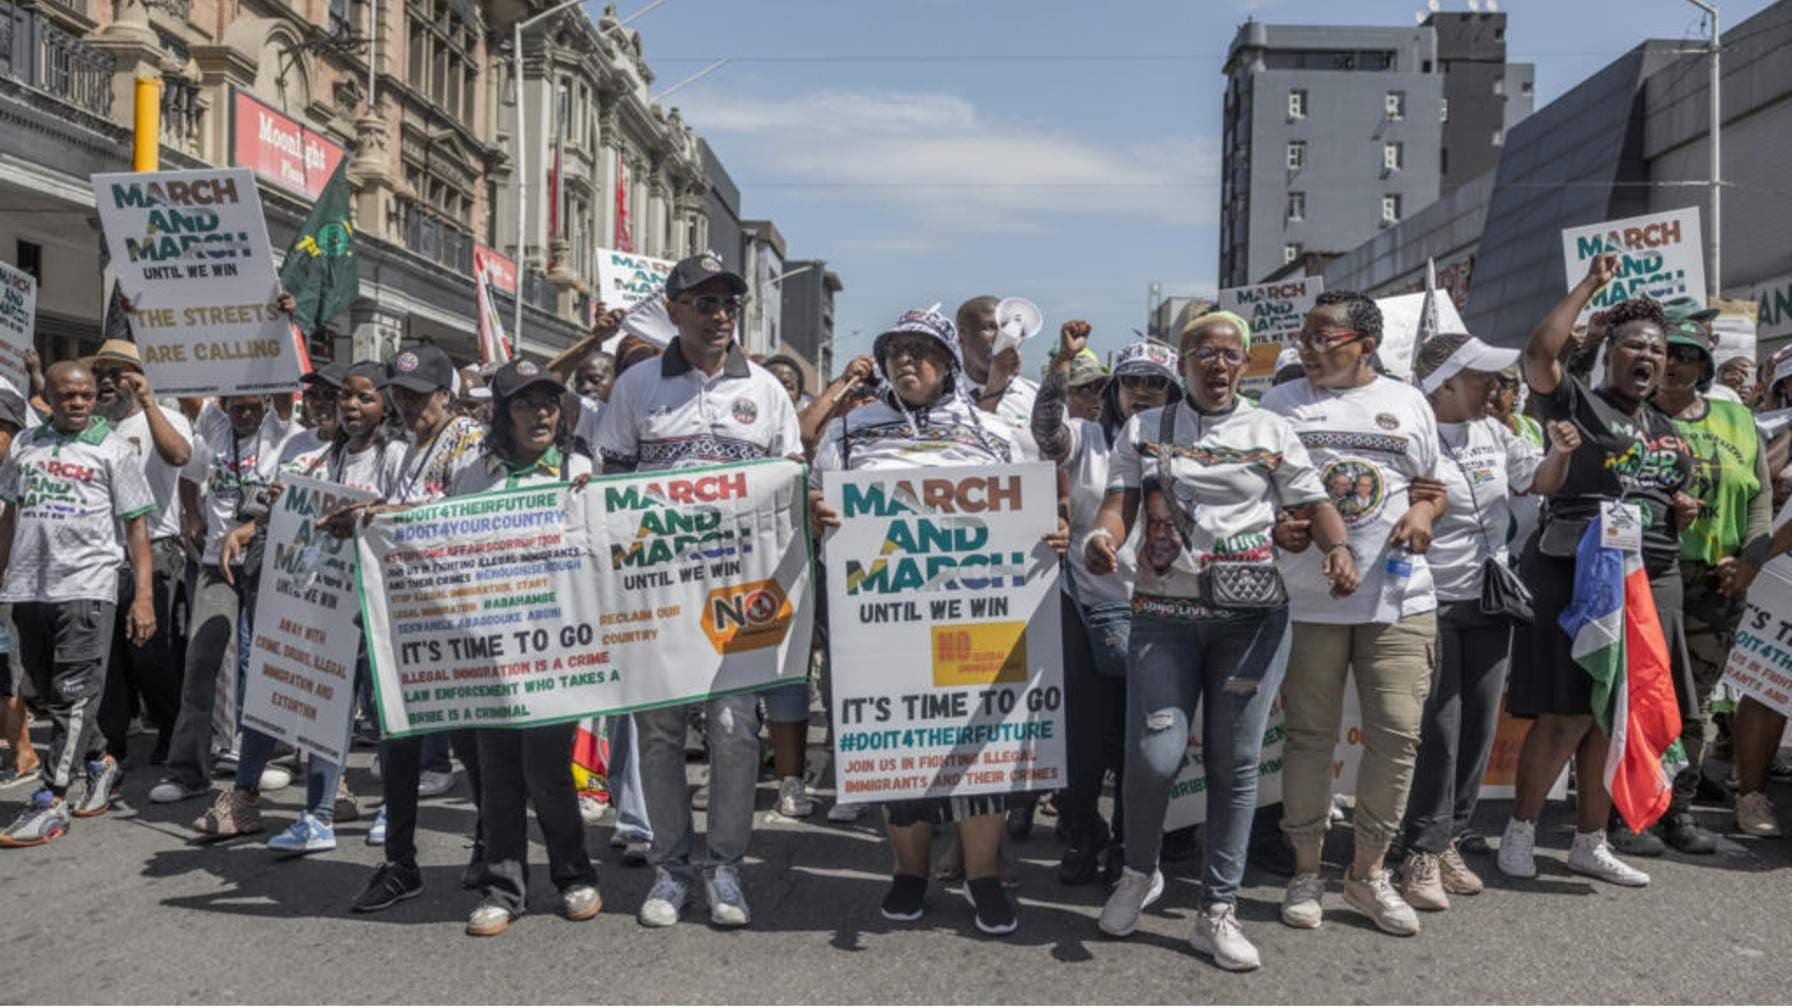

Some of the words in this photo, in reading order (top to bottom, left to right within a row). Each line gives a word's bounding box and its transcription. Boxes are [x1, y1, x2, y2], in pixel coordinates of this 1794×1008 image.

[258, 112, 326, 171] Moonlght
[112, 178, 239, 208] MARCH
[147, 208, 220, 234] AND
[125, 232, 252, 262] MARCH
[1577, 219, 1681, 260] MARCH
[143, 265, 184, 280] UNTIL
[186, 264, 208, 278] WE
[211, 263, 238, 276] WIN
[1237, 282, 1306, 304] MARCH
[136, 308, 177, 328] THE
[184, 303, 280, 326] STREETS
[1252, 302, 1294, 320] AND
[145, 344, 187, 364] ARE
[193, 339, 281, 360] CALLING
[26, 477, 73, 494] AND
[604, 471, 748, 513] MARCH
[842, 475, 1022, 518] MARCH
[285, 484, 357, 519] MAR
[394, 493, 557, 523] #DOIT4THEIRFUTURE
[394, 511, 567, 542] #DOIT4YOURCOUNTRY
[636, 505, 722, 539] AND
[881, 516, 989, 555] AND
[610, 527, 753, 571] MARCH
[624, 571, 674, 591] UNTIL
[679, 565, 705, 582] WE
[711, 561, 742, 578] WIN
[846, 552, 1026, 596] MARCH
[484, 591, 556, 610] #ABAHAMBE
[599, 609, 653, 626] RECLAIM
[656, 605, 681, 618] OUR
[860, 602, 922, 624] UNTIL
[929, 599, 962, 620] WE
[970, 596, 1009, 618] WIN
[402, 640, 442, 665] IT'S
[447, 634, 504, 660] TIME
[514, 628, 549, 654] TO
[560, 623, 593, 648] GO
[602, 629, 659, 646] COUNTRY
[938, 630, 972, 663] NO
[402, 670, 449, 685] ILLEGAL
[453, 661, 531, 680] IMMIGRATION
[535, 659, 547, 672] IS
[553, 658, 562, 671] A
[568, 651, 610, 668] CRIME
[404, 688, 430, 703] LAW
[435, 683, 520, 702] ENFORCEMENT
[524, 677, 555, 692] WHO
[560, 671, 605, 689] TAKES
[610, 669, 621, 682] A
[408, 709, 444, 725] BRIBE
[448, 708, 459, 721] IS
[464, 706, 472, 719] A
[475, 703, 531, 719] CRIMINAL
[842, 697, 891, 724] IT'S
[902, 692, 968, 720] TIME
[979, 687, 1015, 716] TO
[1026, 686, 1062, 712] GO
[840, 720, 1053, 752] #DOIT4THEIRFUTURE
[845, 757, 874, 773] JOIN
[879, 756, 896, 770] US
[901, 756, 914, 769] IN
[919, 752, 979, 768] FIGHTING
[983, 750, 1037, 764] ILLEGAL
[845, 776, 928, 793] IMMIGRANTS
[934, 774, 960, 786] AND
[966, 771, 1005, 785] THEIR
[1010, 767, 1058, 781] CRIMES
